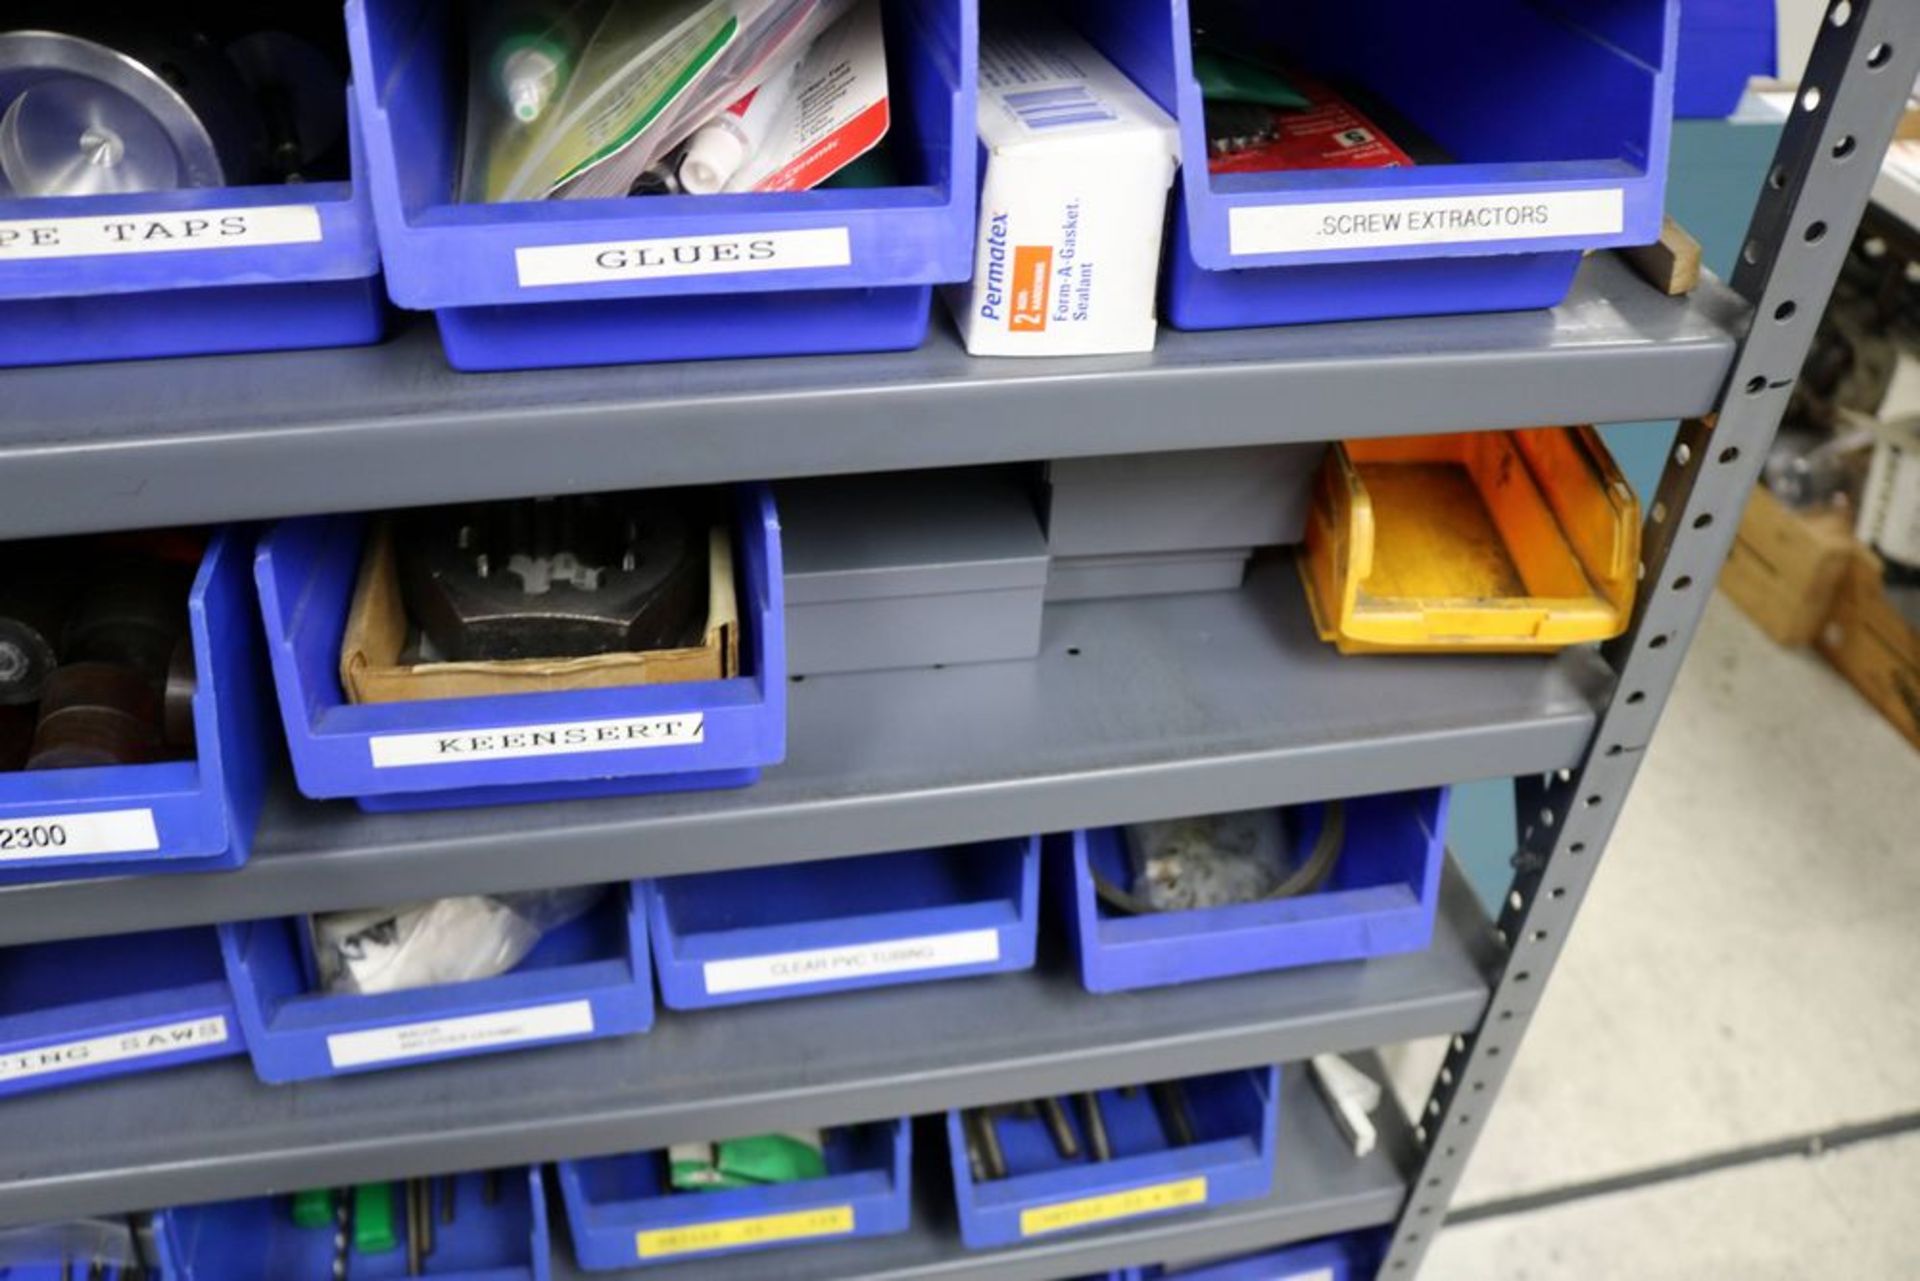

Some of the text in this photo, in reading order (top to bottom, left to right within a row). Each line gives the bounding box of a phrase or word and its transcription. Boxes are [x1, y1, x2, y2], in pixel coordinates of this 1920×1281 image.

[104, 215, 248, 242] TAPS
[1408, 204, 1549, 231] EXTRACTORS
[595, 240, 776, 269] GLUES
[980, 212, 1009, 321] Permatex
[1073, 262, 1094, 321] Sealant
[1013, 312, 1042, 325] 2
[0, 824, 67, 850] 2300
[770, 945, 936, 977] CLEAR PVC TUBING
[120, 1023, 219, 1052] SAWS
